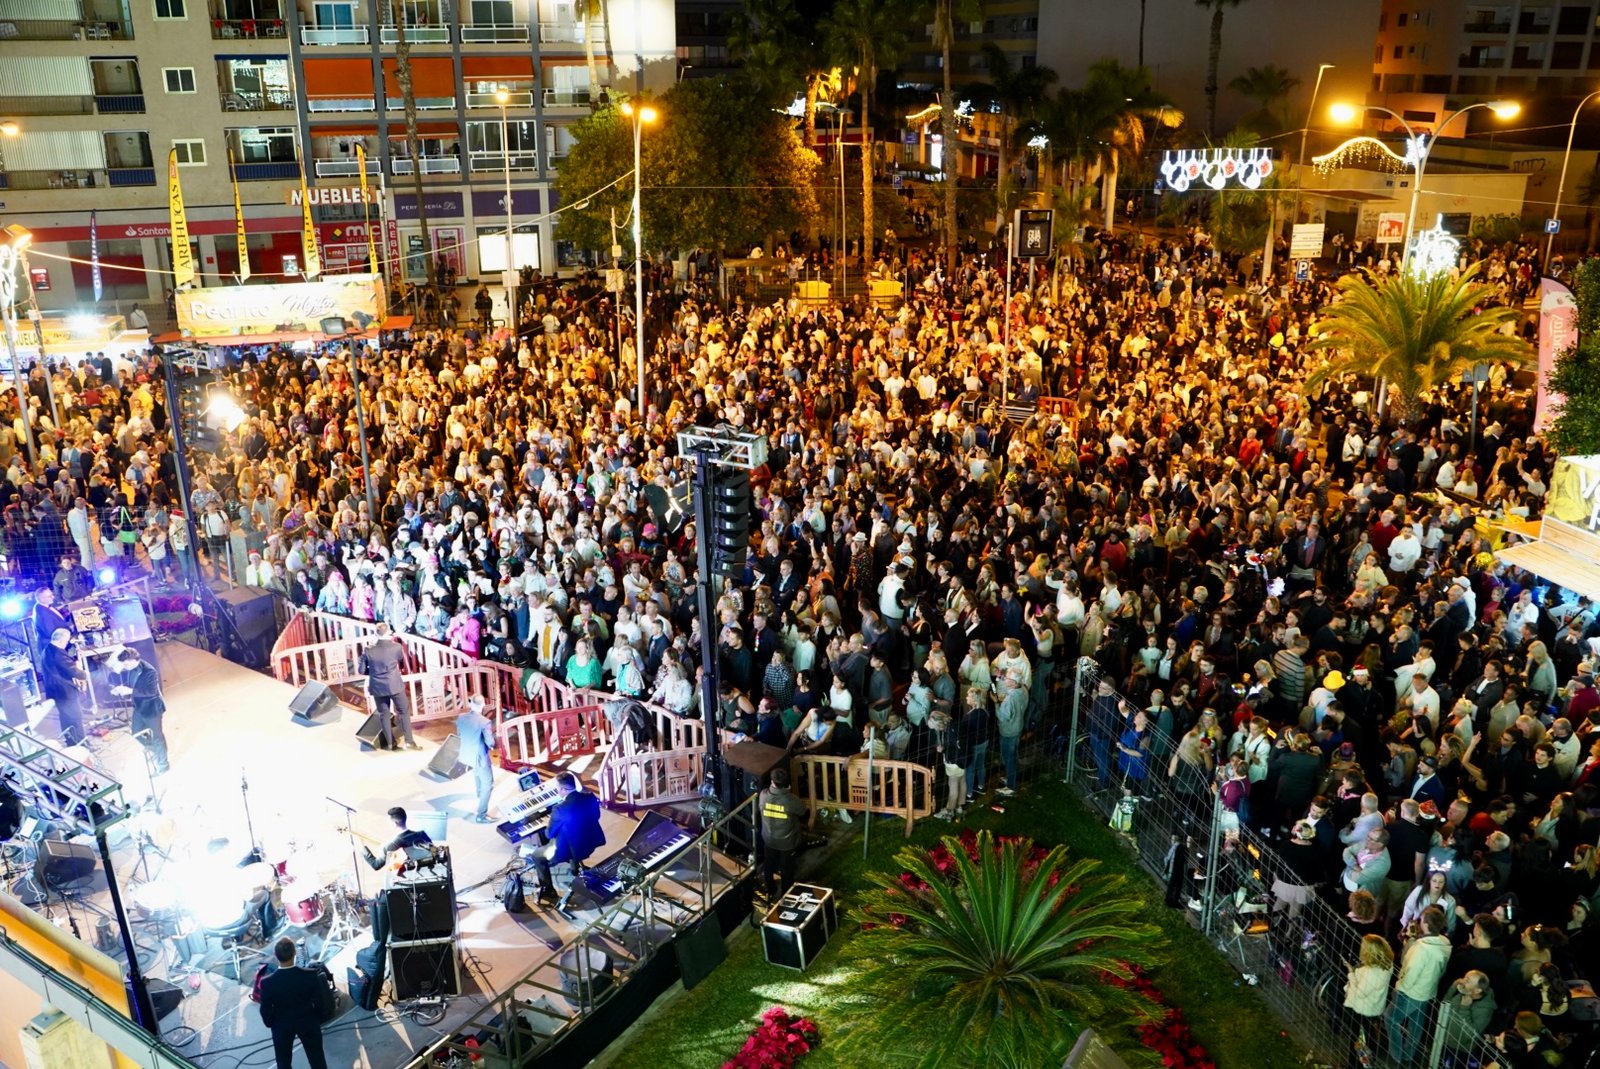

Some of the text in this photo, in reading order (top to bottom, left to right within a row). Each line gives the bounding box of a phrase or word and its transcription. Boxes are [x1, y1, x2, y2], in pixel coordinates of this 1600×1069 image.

[291, 188, 371, 206] MUEBLES
[137, 227, 170, 236] Santan
[171, 184, 192, 270] AREHUCAS
[1547, 221, 1558, 231] P
[1299, 262, 1308, 274] P
